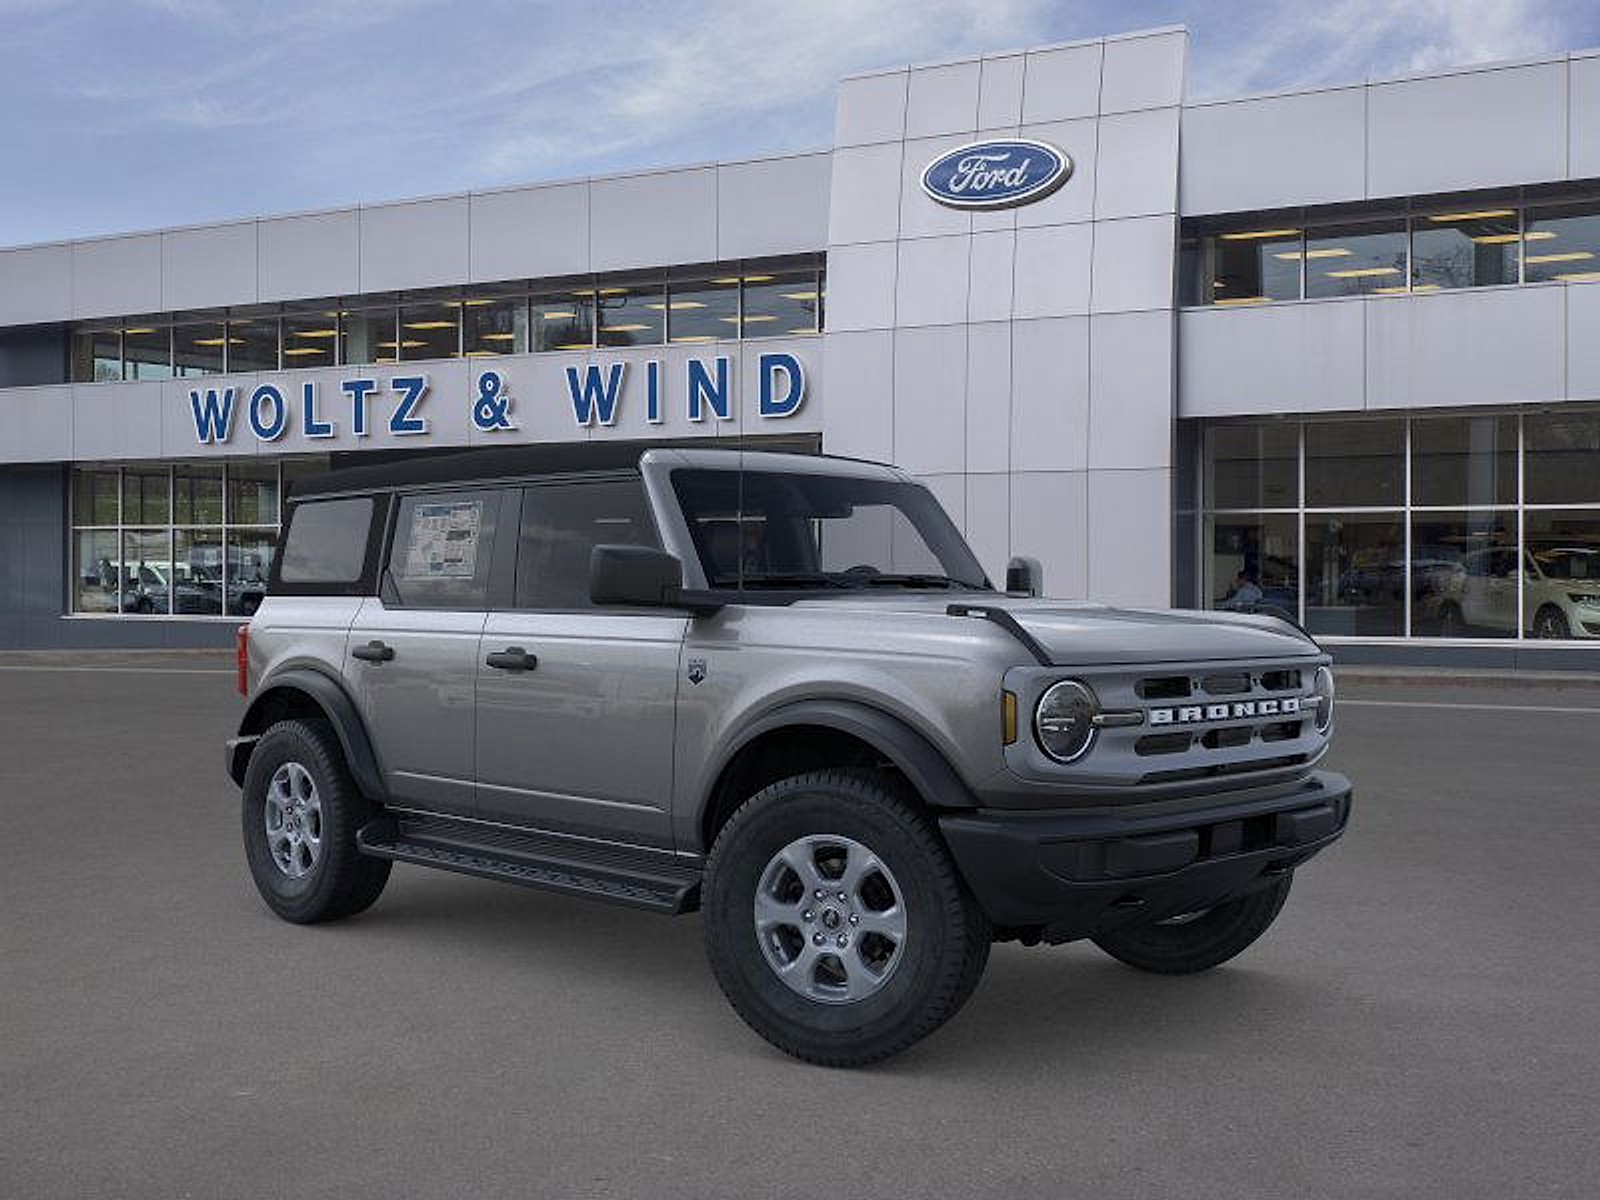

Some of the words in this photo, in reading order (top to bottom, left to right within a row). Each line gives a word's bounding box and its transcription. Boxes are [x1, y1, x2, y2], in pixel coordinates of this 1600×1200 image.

[949, 152, 1031, 193] Ford
[190, 375, 431, 443] WOLTZ
[470, 369, 517, 432] &
[565, 352, 807, 426] WIND
[1150, 698, 1300, 724] BRONCO
